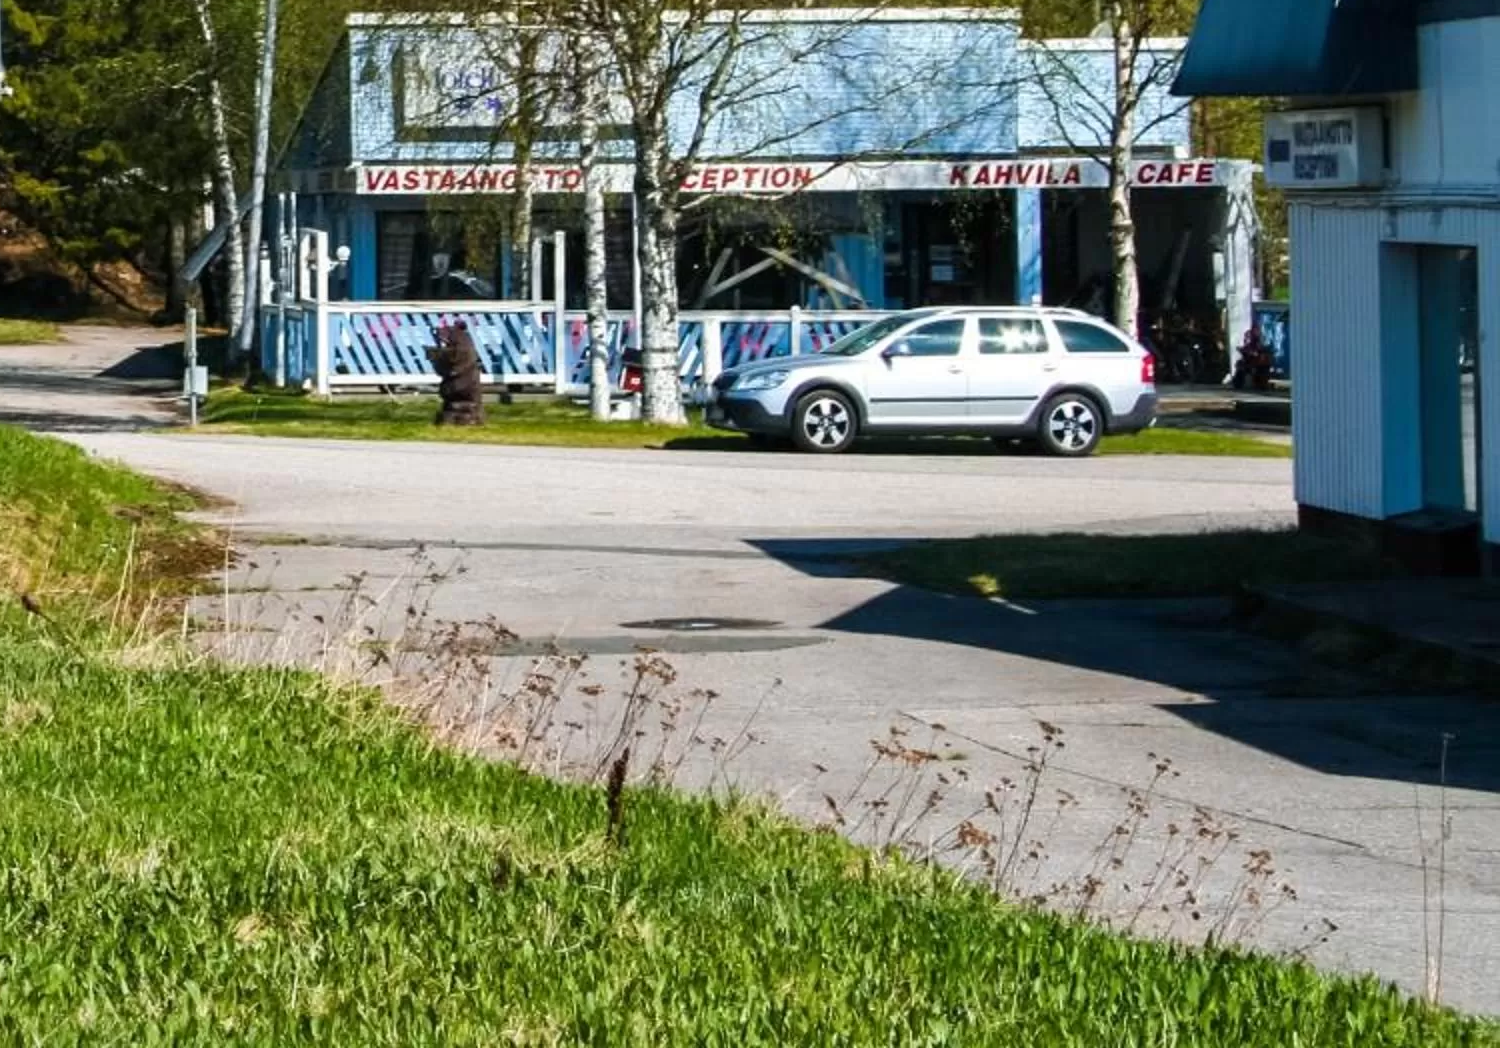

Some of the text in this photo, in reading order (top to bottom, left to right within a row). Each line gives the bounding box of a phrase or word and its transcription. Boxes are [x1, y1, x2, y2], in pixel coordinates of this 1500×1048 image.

[365, 168, 582, 191] VASTAANOTO
[949, 163, 1215, 186] KAHVILA CAFE
